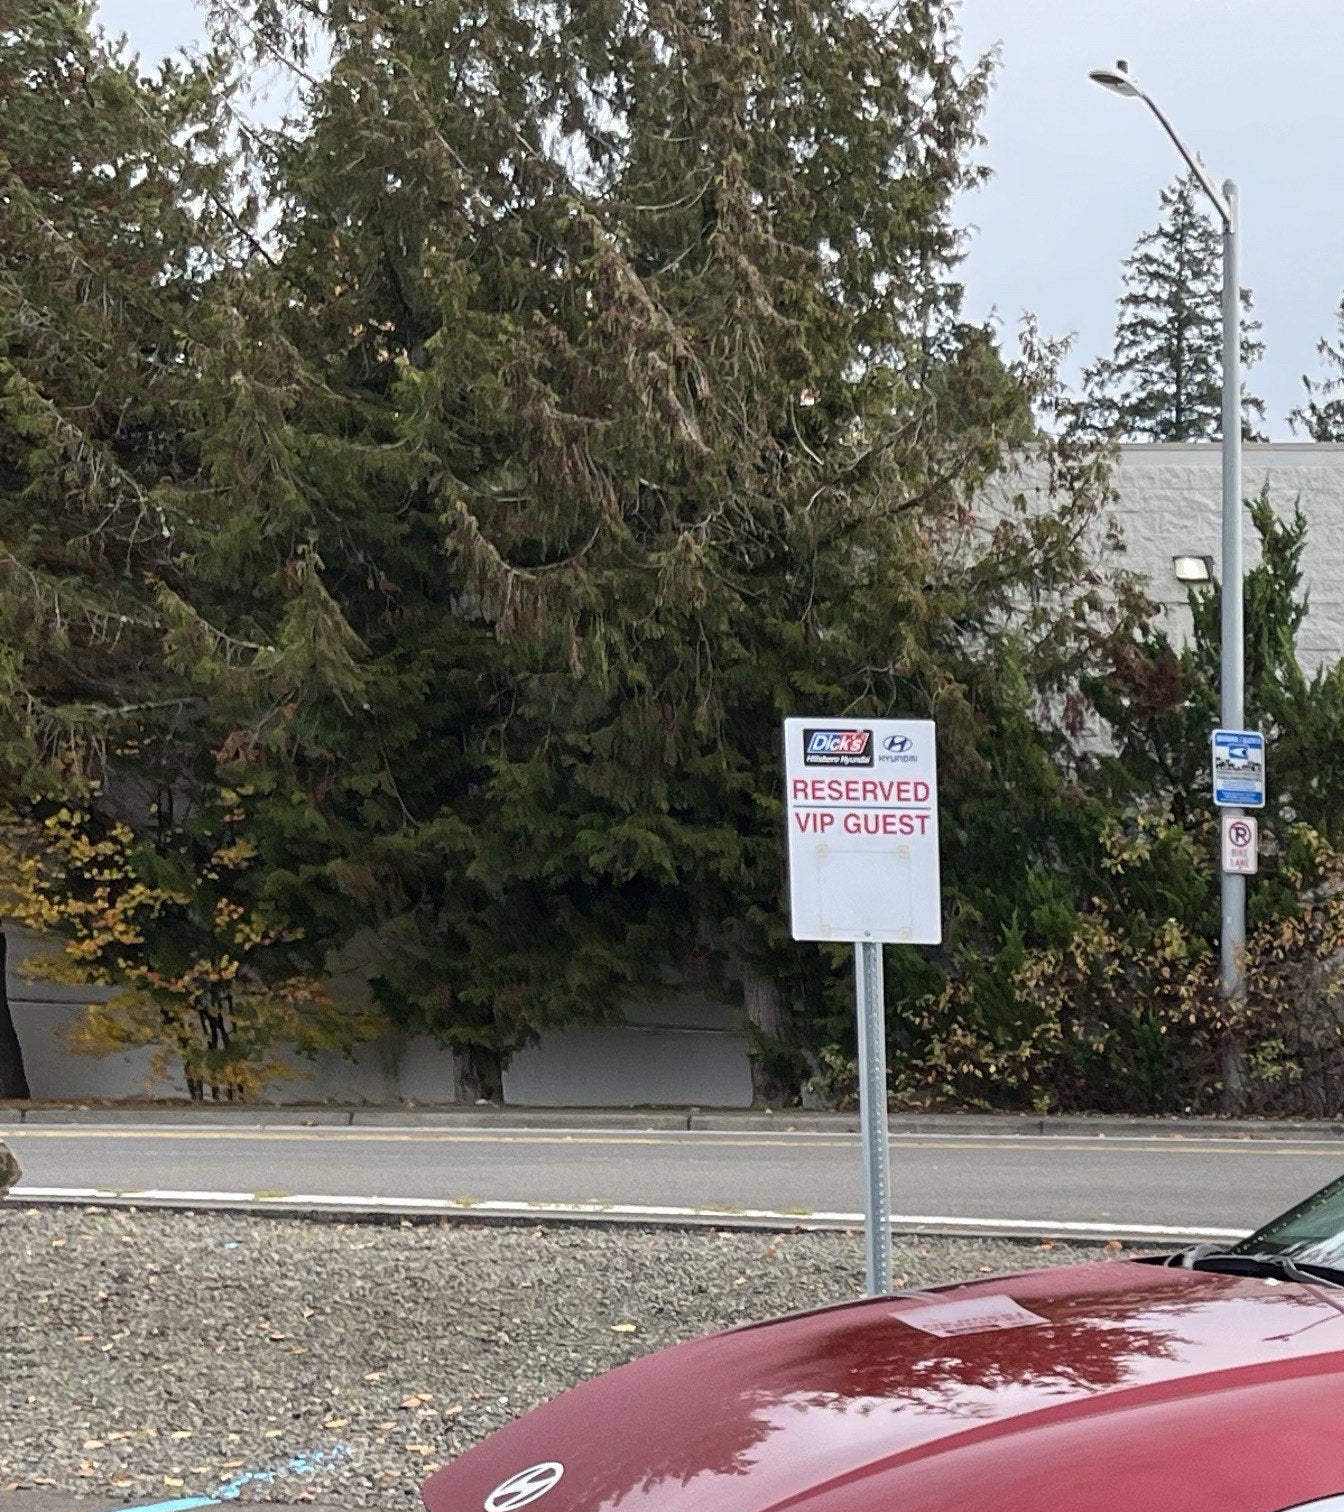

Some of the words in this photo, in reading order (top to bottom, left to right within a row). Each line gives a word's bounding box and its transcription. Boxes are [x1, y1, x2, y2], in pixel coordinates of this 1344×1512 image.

[792, 780, 930, 802] RESERVED
[795, 812, 834, 833] VIP
[843, 813, 930, 835] GUEST
